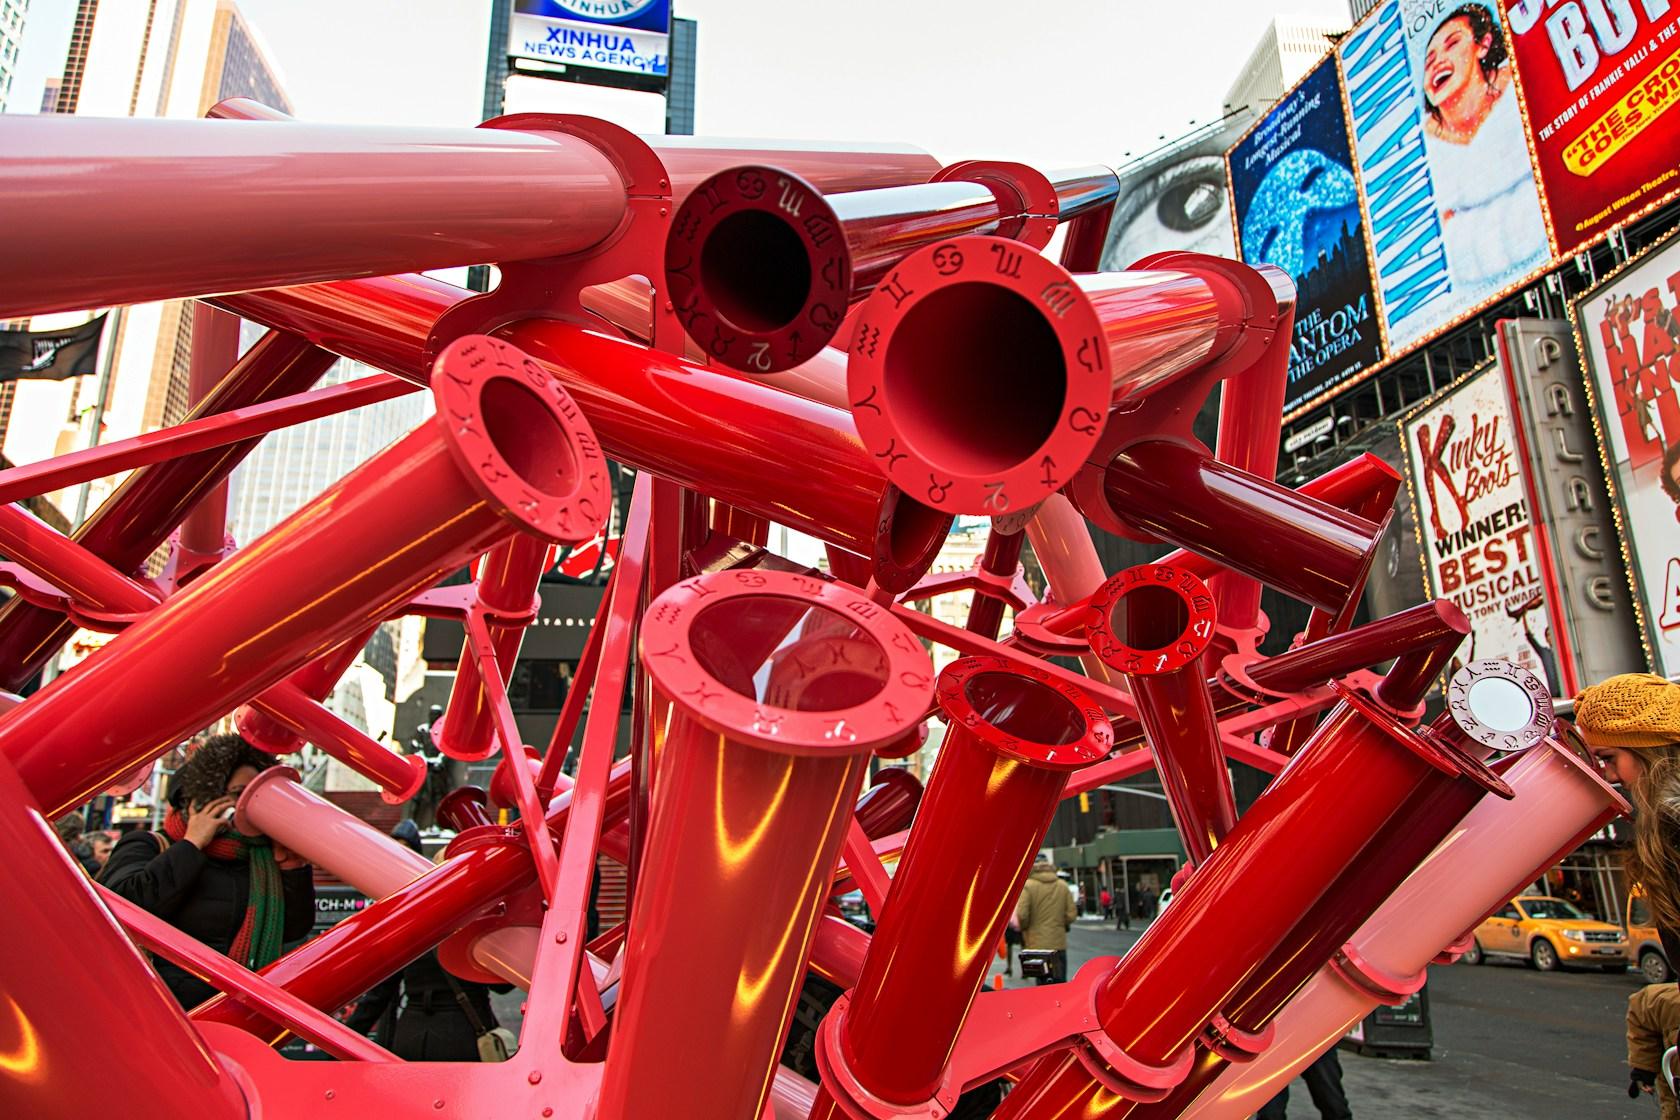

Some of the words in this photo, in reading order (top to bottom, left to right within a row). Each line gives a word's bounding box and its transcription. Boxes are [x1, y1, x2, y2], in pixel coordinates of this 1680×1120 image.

[564, 0, 634, 14] INHUA
[1406, 0, 1446, 39] LOVE
[525, 40, 576, 58] NEWS
[582, 49, 656, 68] AGENCY
[546, 27, 635, 53] XINHUA
[1545, 0, 1671, 92] BO
[1538, 127, 1555, 142] THE
[1553, 105, 1579, 130] STORY
[1578, 94, 1590, 110] OF
[1588, 66, 1624, 100] FRANKIE
[1623, 46, 1649, 71] VALLI
[1648, 39, 1659, 51] &
[1656, 22, 1678, 44] THE
[1626, 53, 1680, 109] CRO
[1244, 92, 1320, 170] Longest-Running
[1265, 123, 1301, 167] Musical
[1579, 108, 1643, 167] GOES
[1362, 105, 1452, 329] MAMMA
[1612, 189, 1642, 211] Wilson
[1640, 169, 1679, 193] Theatre,
[1287, 293, 1369, 370] ANTOM
[1295, 307, 1322, 337] THE
[1288, 355, 1315, 384] THE
[1315, 328, 1362, 366] OPERA
[1464, 451, 1520, 503] Boots
[1536, 336, 1615, 612] PALACE
[1435, 499, 1528, 558] WINNER!
[1439, 525, 1530, 594] BEST
[1474, 600, 1502, 620] TONY
